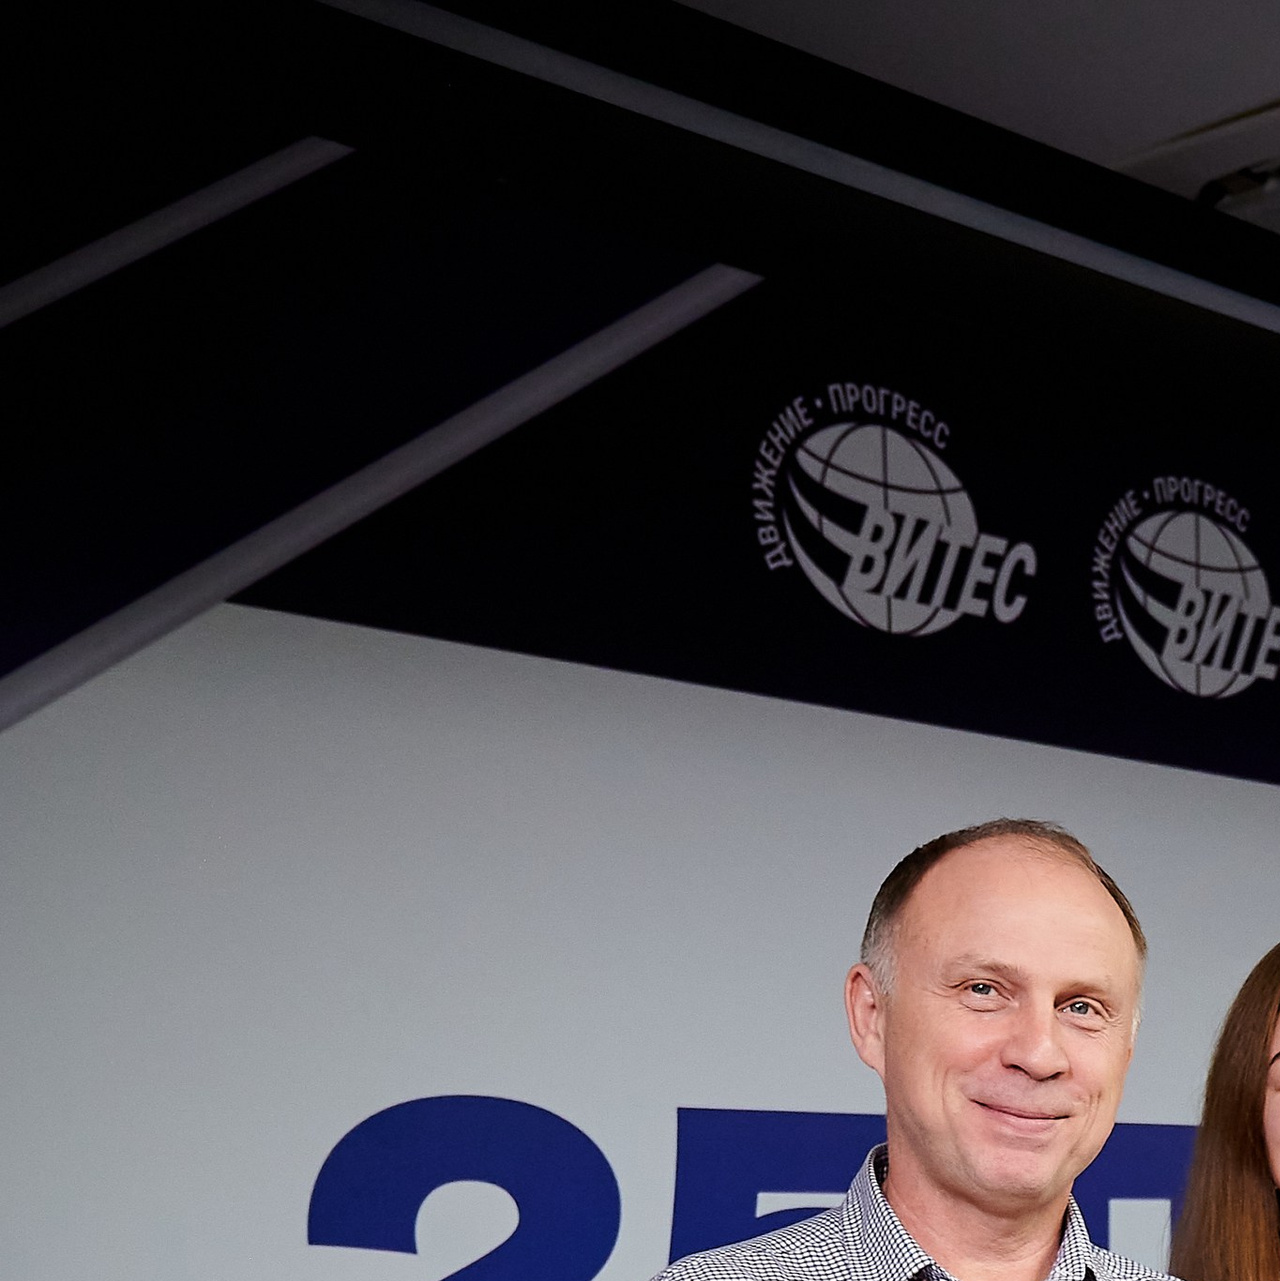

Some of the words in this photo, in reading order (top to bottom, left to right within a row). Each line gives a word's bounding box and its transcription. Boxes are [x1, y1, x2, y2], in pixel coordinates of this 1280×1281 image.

[750, 394, 815, 572] ДВИЖЕНИЕ
[826, 381, 951, 450] ПРОГРЕСС
[1090, 489, 1144, 644] ДВИЖЕНИЕ
[1151, 475, 1251, 533] ПРОГРЕСС
[838, 503, 1039, 625] ВИТЕС
